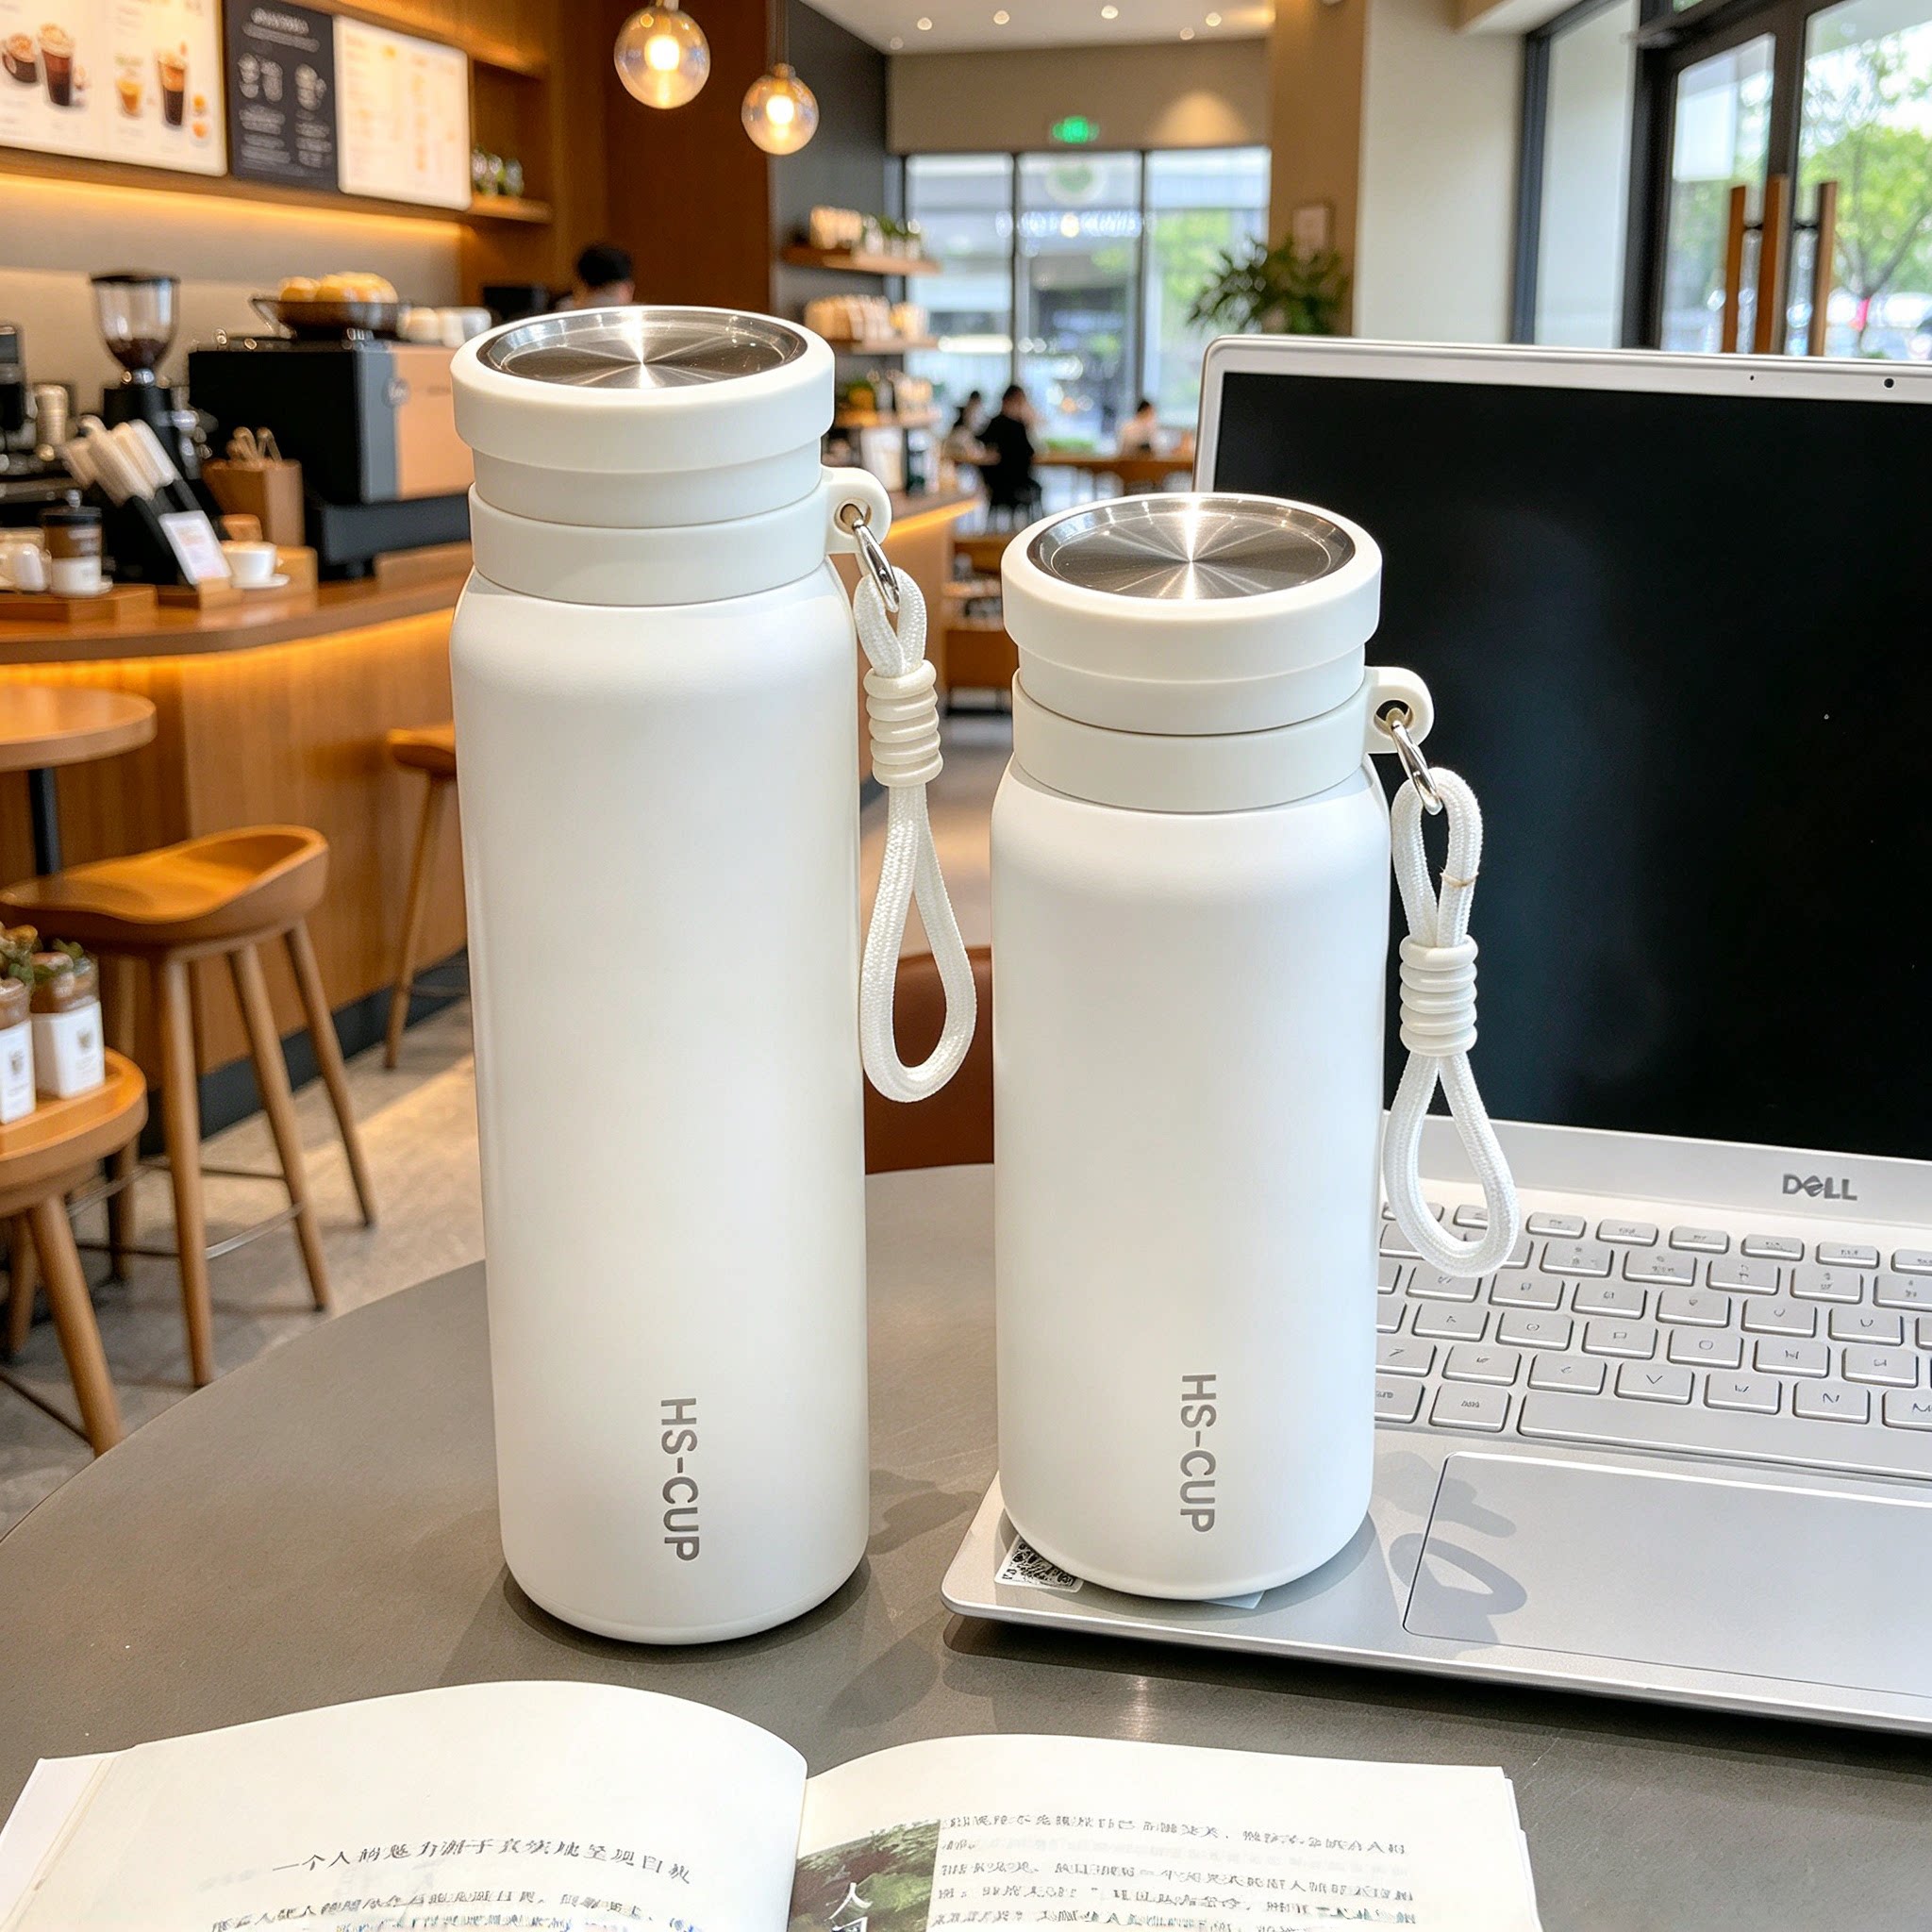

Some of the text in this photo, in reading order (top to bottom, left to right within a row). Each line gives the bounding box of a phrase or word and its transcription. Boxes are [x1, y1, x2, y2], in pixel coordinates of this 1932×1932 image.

[1783, 1174, 1858, 1202] DELL
[660, 1397, 700, 1561] HS-CUP
[1179, 1374, 1217, 1533] HS-CUP
[827, 1882, 874, 1932] 人
